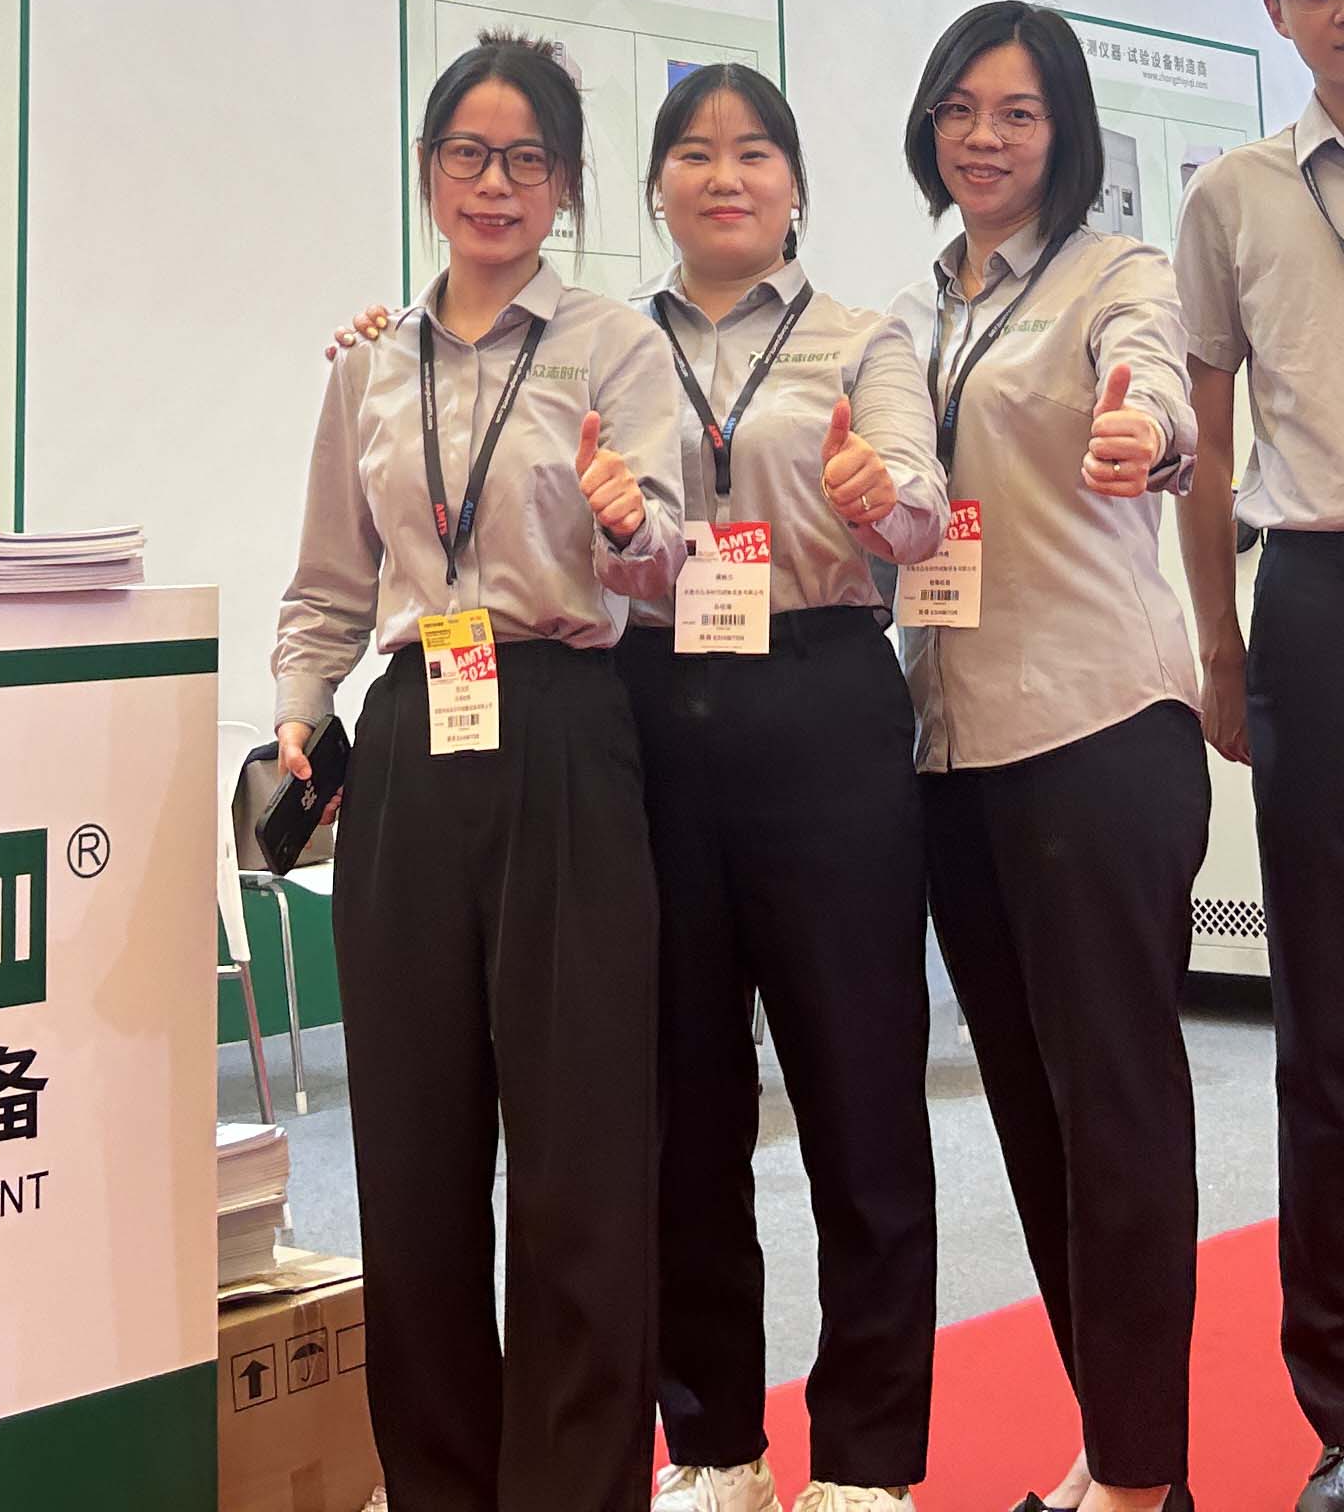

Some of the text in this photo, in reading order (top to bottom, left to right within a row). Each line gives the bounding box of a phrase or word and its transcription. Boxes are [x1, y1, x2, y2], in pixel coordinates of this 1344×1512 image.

[950, 506, 978, 526] MTS
[718, 528, 766, 550] AMTS
[948, 520, 981, 539] 024
[720, 545, 770, 563] 2024
[456, 644, 492, 668] AMTS
[460, 662, 496, 681] 2024
